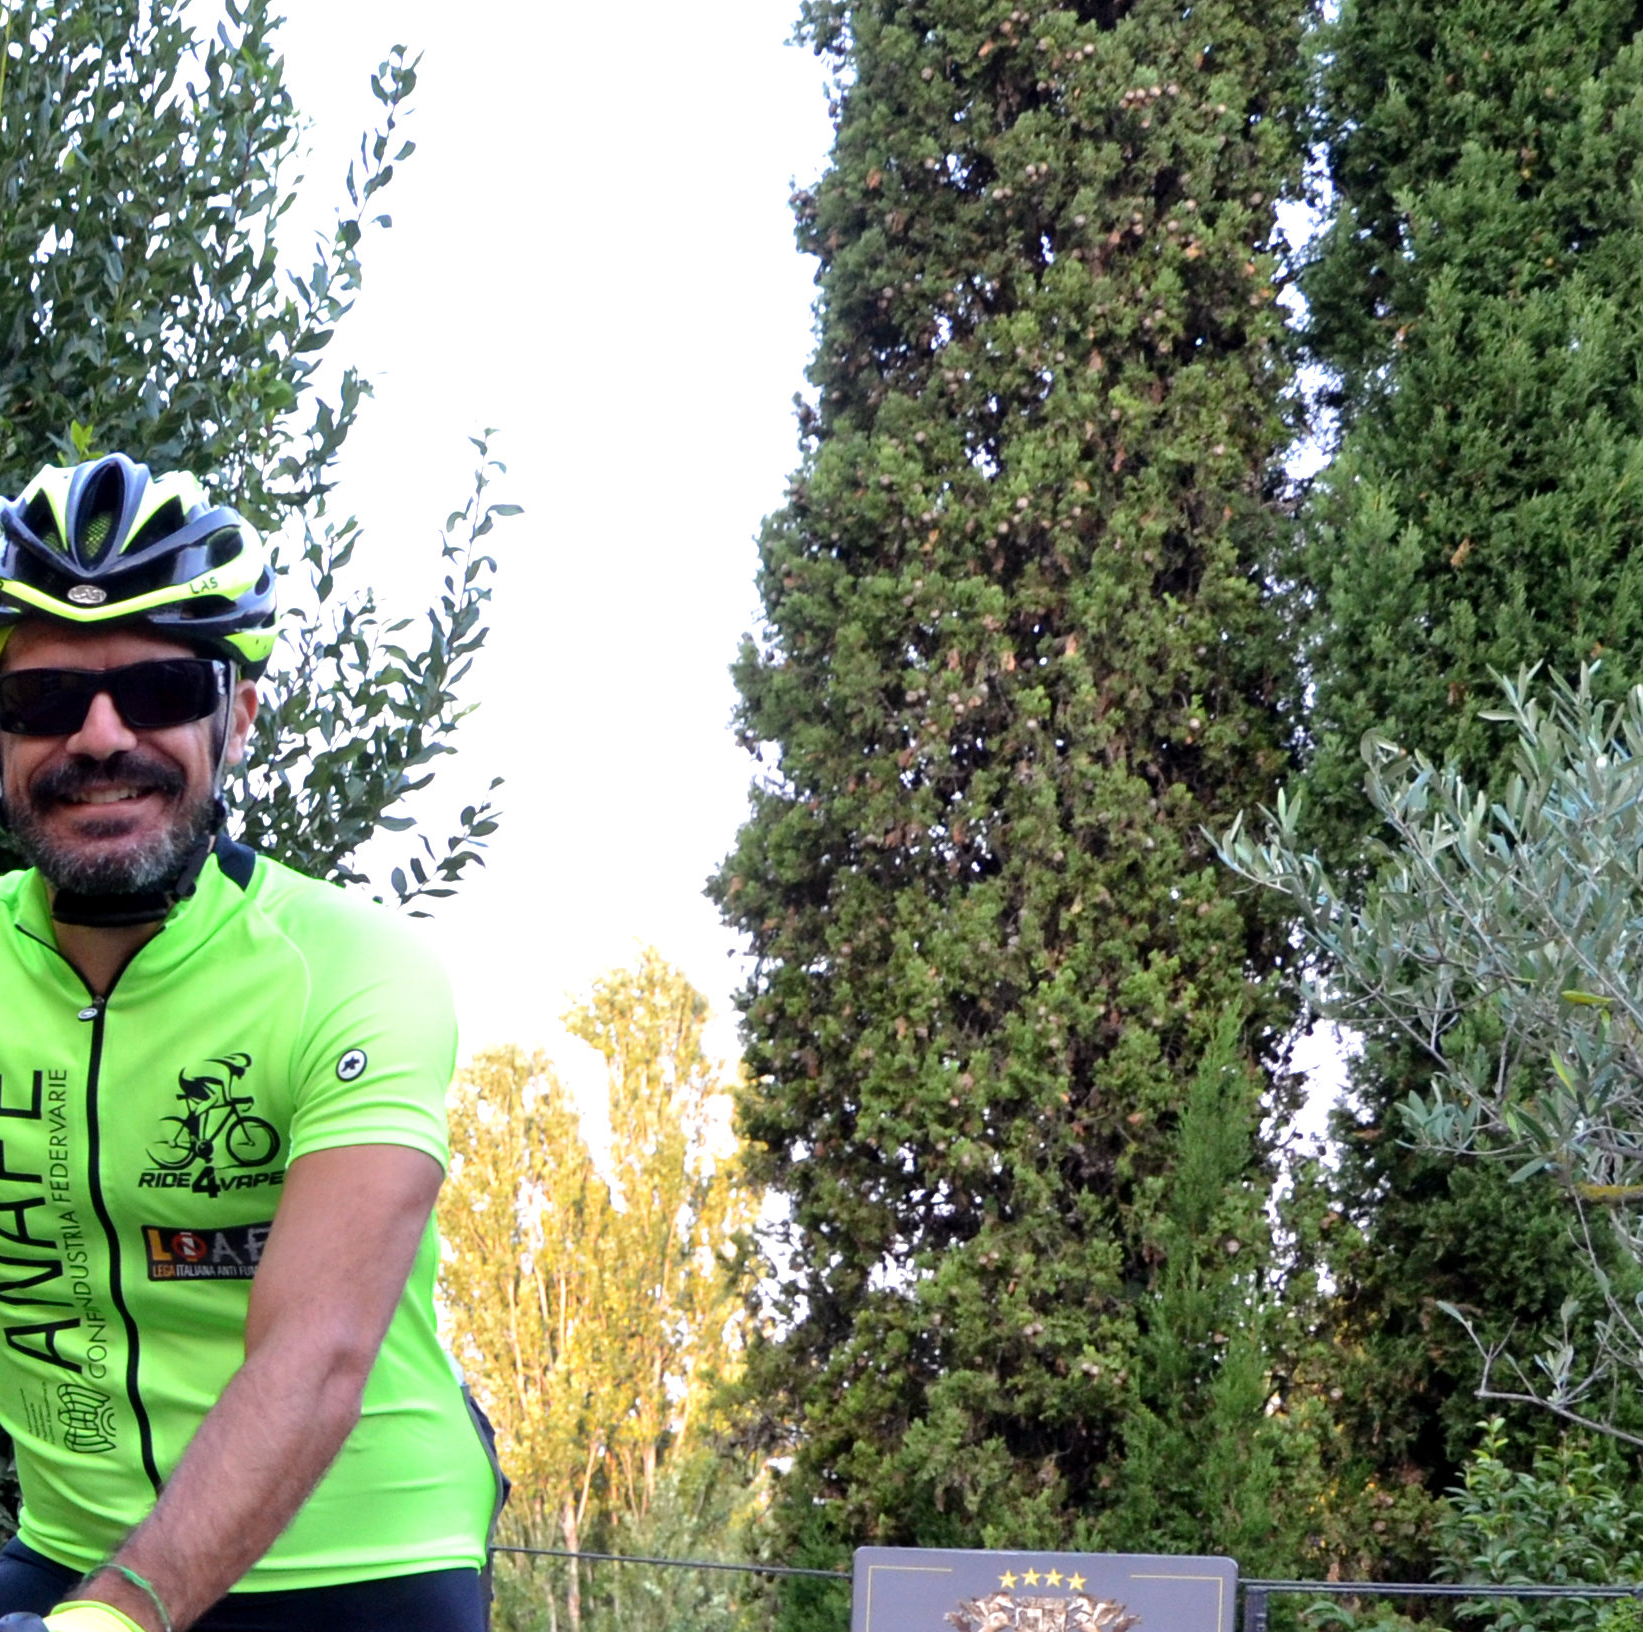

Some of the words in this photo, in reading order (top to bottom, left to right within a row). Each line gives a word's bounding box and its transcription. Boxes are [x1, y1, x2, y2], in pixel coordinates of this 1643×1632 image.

[47, 1068, 69, 1206] FEDERVARIE
[59, 1207, 109, 1379] CONFINDUSTRIA
[152, 1265, 176, 1278] LEGA
[176, 1264, 215, 1277] ITALIANA
[217, 1265, 237, 1276] ANTI
[238, 1265, 259, 1276] FUM
